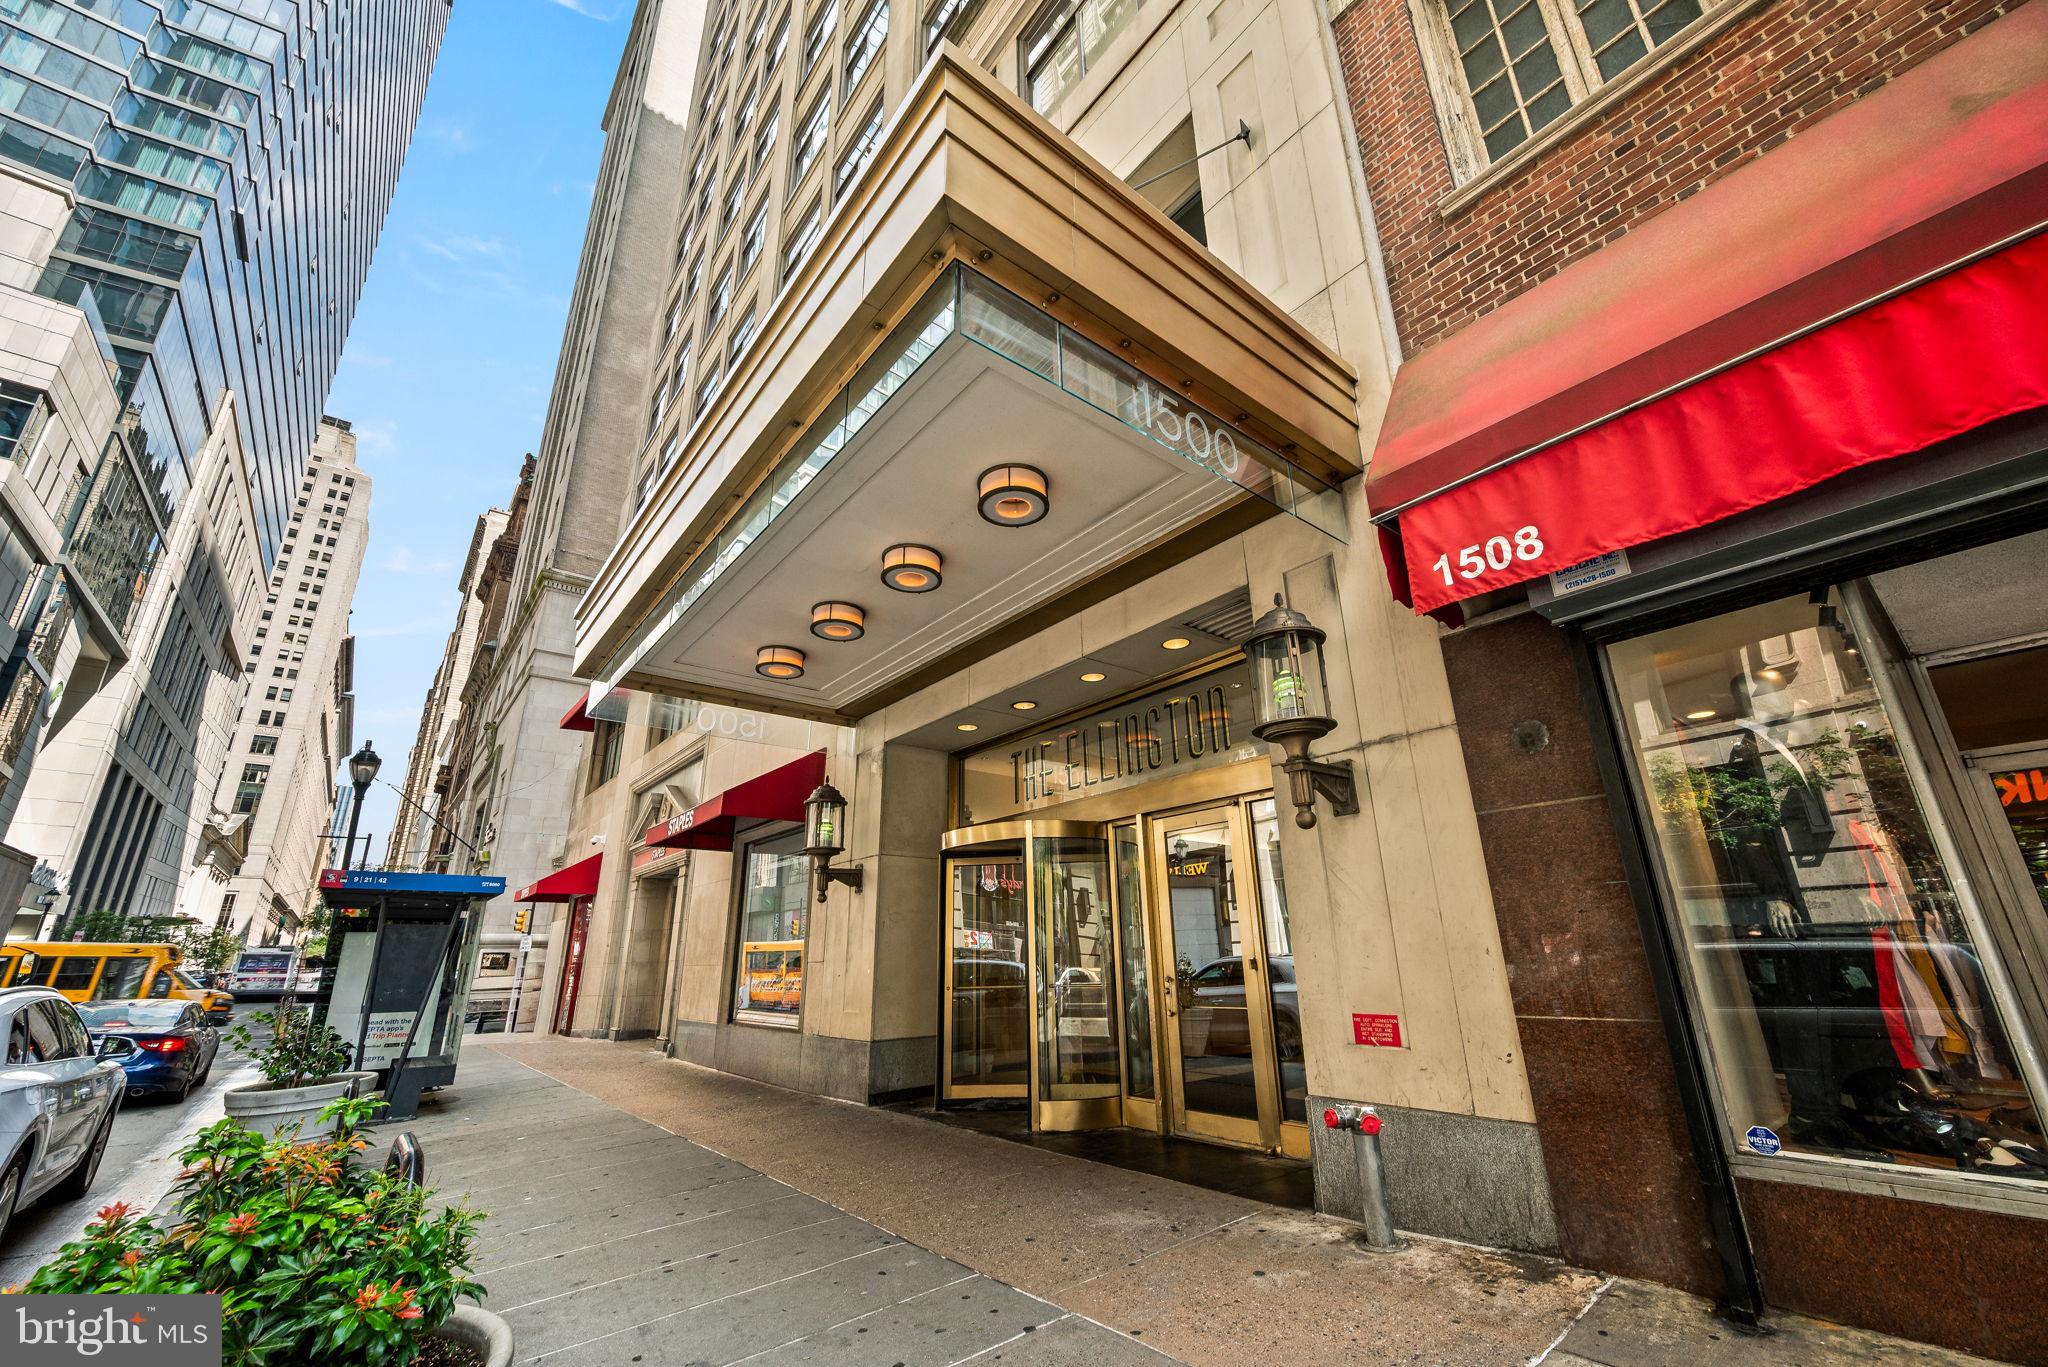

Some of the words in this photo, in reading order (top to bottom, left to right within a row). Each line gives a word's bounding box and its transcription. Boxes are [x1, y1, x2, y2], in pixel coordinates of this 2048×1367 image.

[1137, 380, 1239, 474] 1500
[1432, 525, 1545, 587] 1508
[1010, 741, 1055, 805] THE
[1065, 684, 1233, 792] ELLINGTON
[667, 809, 695, 837] STAPLES
[1748, 1136, 1779, 1146] VICTOR
